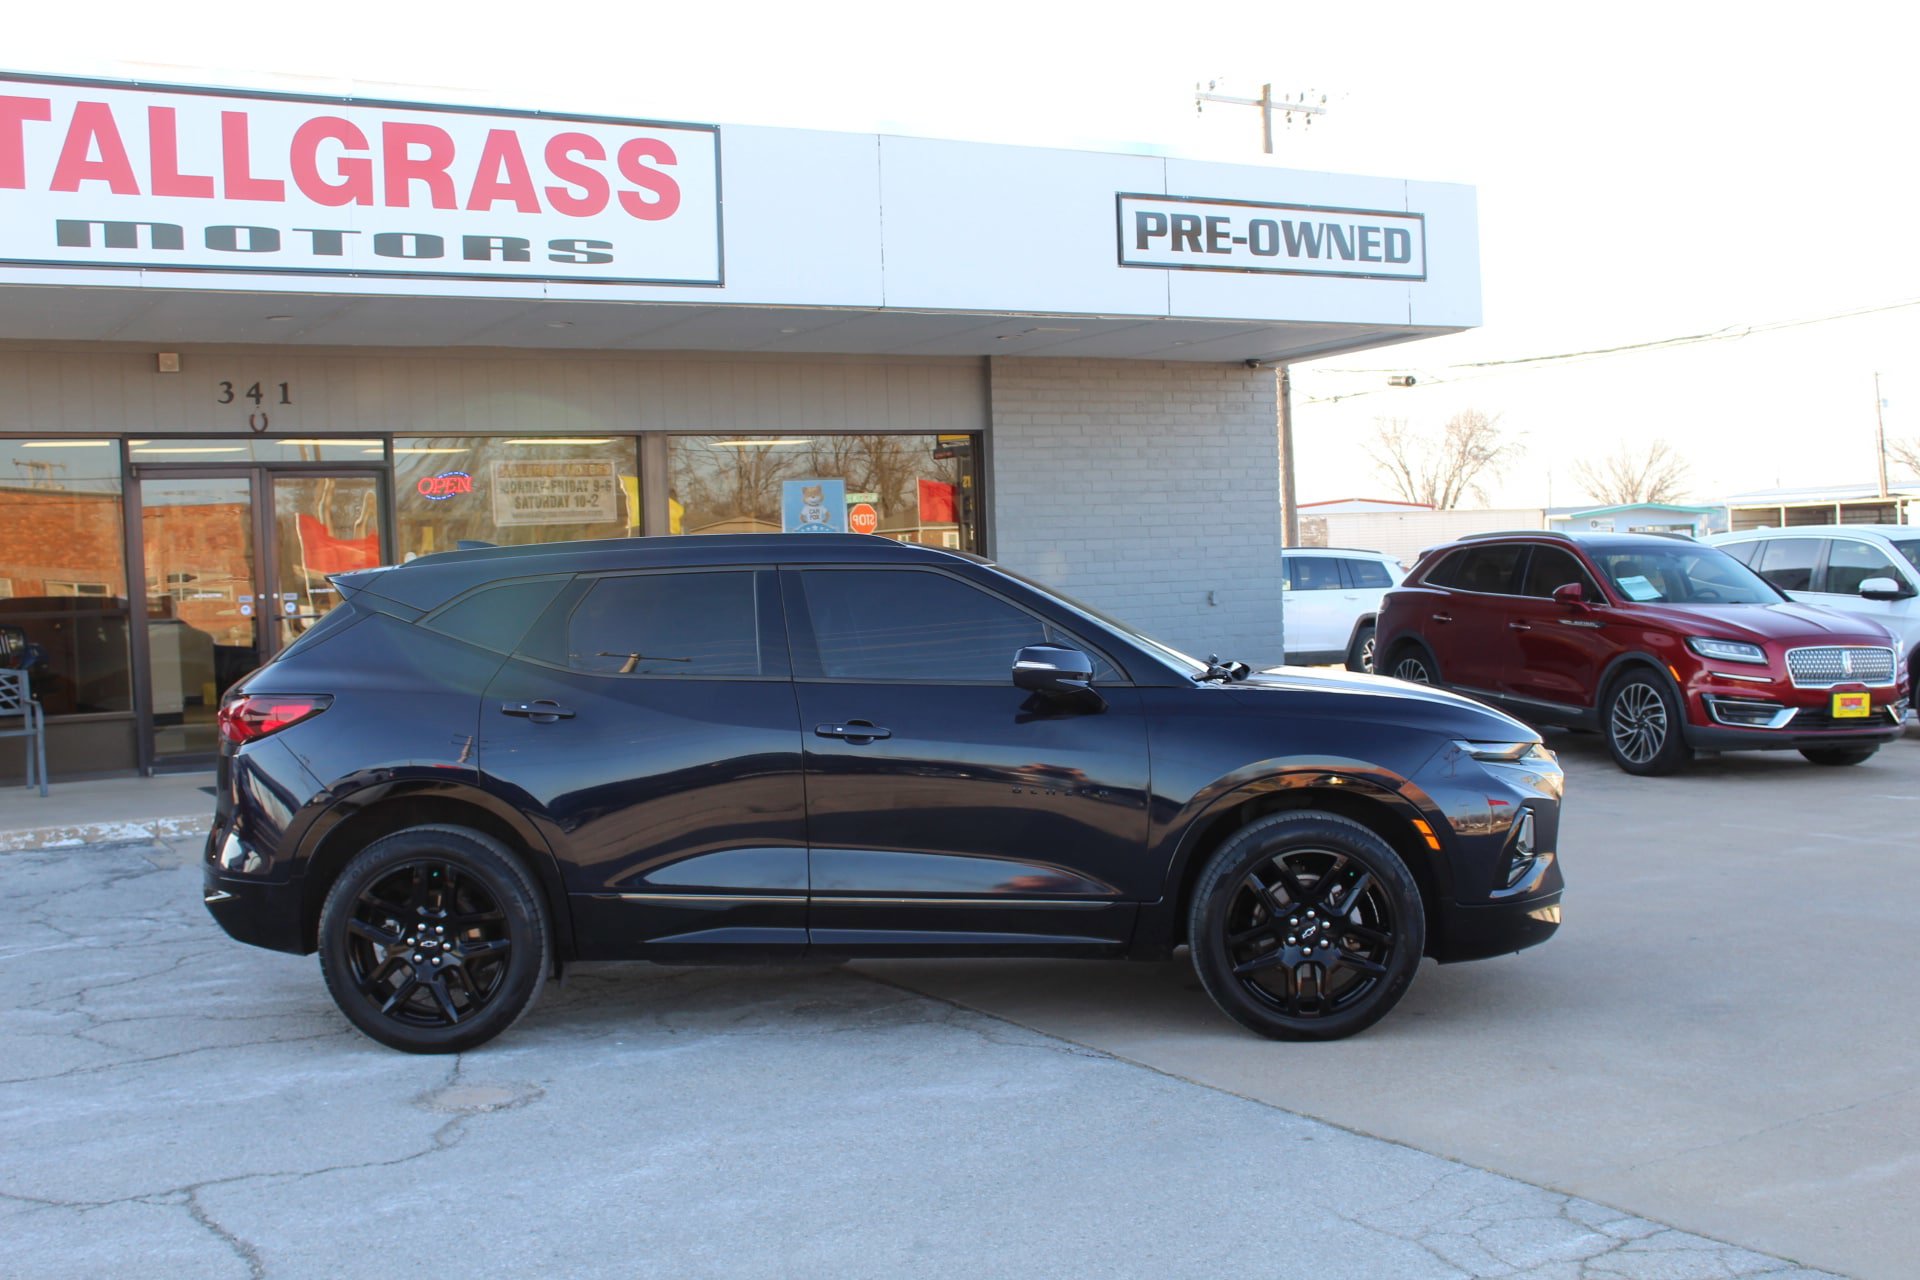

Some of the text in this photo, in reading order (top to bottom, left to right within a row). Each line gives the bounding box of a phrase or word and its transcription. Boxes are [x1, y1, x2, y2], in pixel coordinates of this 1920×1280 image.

[0, 95, 681, 221] TALLGRASS
[56, 219, 614, 264] MOTORS
[1135, 211, 1411, 264] PRE-OWNED
[217, 381, 292, 405] 341
[417, 476, 473, 495] OPEN
[514, 494, 600, 510] SATURDAY 10-2
